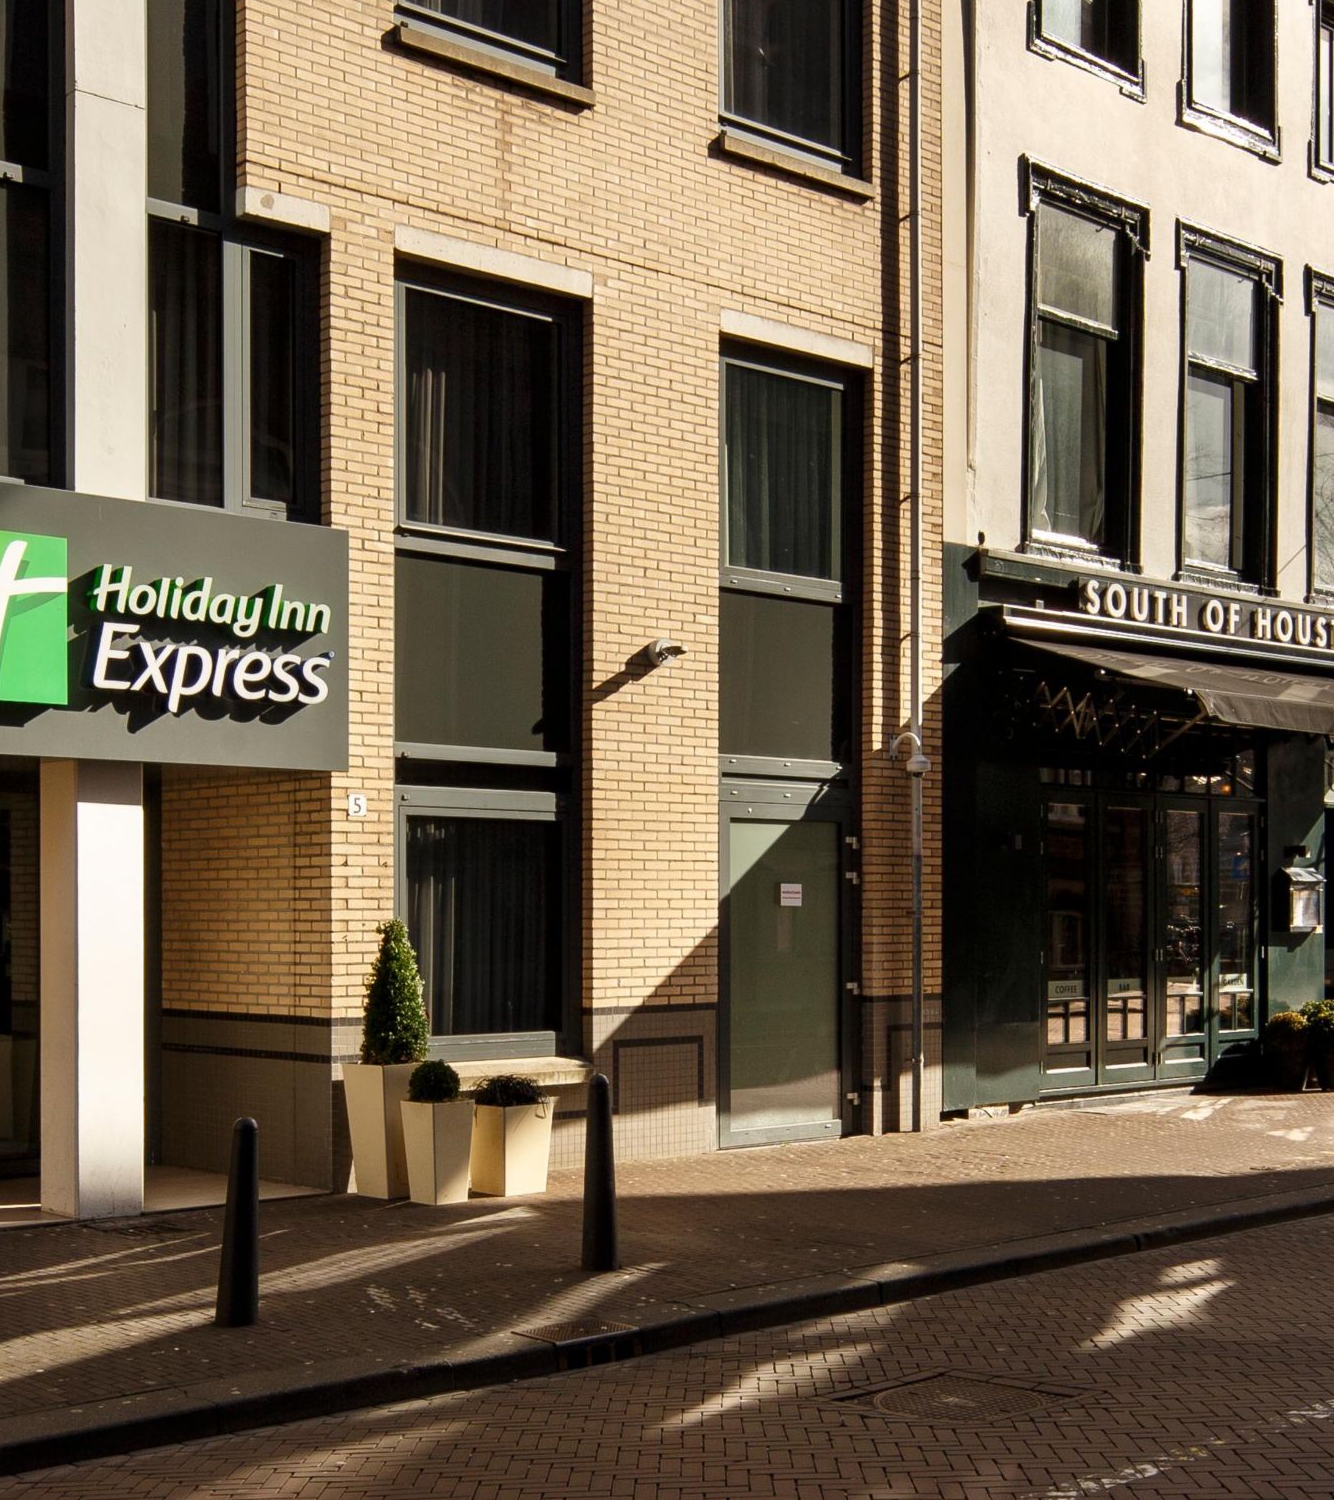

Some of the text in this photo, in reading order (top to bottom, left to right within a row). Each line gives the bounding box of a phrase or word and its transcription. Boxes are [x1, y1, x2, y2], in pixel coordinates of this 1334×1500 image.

[93, 564, 331, 637] Holiday Inn
[1084, 579, 1188, 627] SOUTH
[1203, 599, 1241, 635] OF
[93, 621, 331, 713] Express
[352, 797, 362, 814] 5
[1055, 985, 1077, 995] COFFEE
